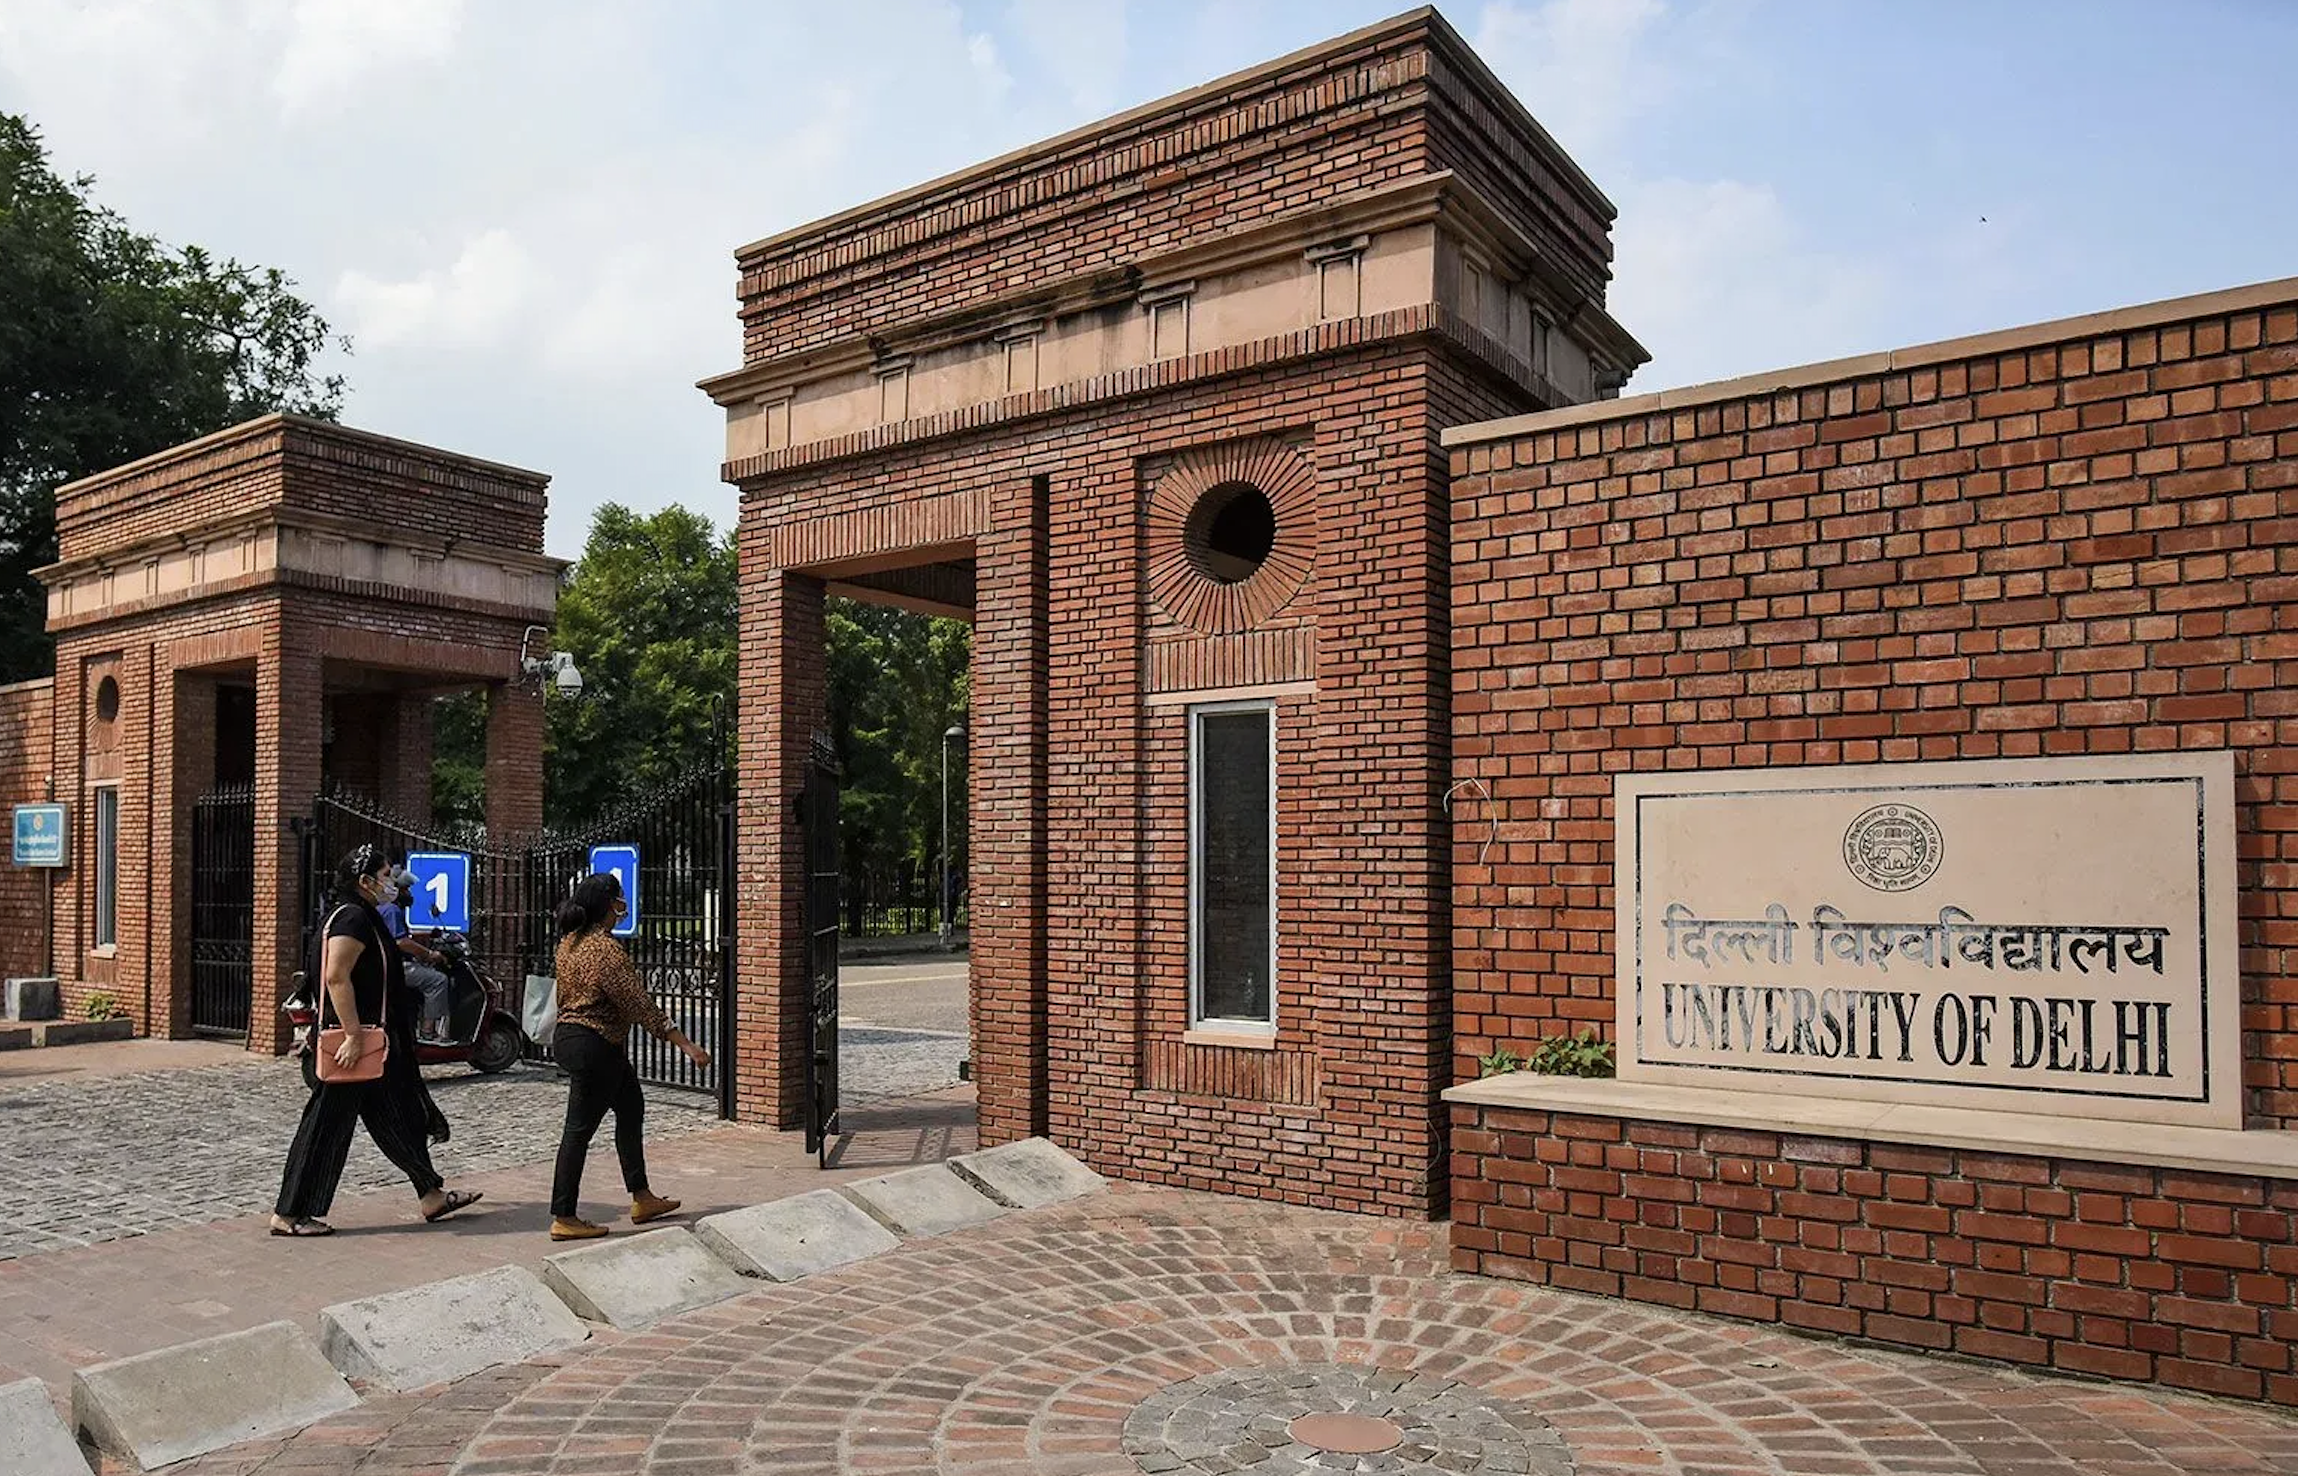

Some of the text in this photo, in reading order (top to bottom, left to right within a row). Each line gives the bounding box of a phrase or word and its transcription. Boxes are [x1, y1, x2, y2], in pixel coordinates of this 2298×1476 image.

[425, 872, 449, 913] 1
[1661, 903, 2171, 975] दिल्ली विश्वविद्यालय
[1662, 983, 2174, 1078] UNIVERSITY OF DELHI
